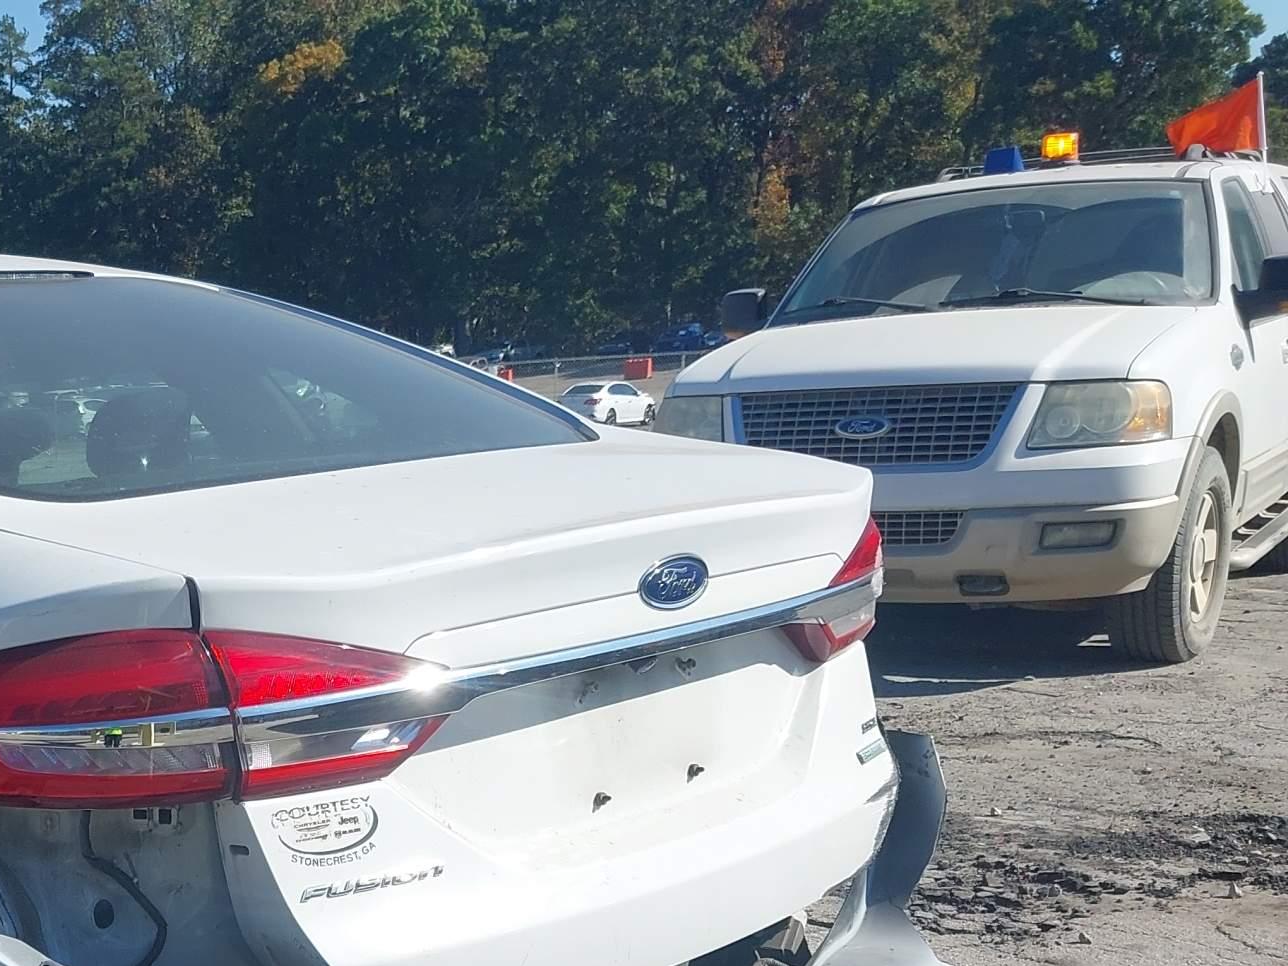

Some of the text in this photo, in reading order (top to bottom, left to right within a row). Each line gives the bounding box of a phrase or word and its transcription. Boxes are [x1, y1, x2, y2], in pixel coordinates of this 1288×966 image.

[273, 795, 371, 822] COURTESY
[338, 815, 360, 826] Jeep
[362, 841, 377, 856] GA
[299, 864, 445, 904] FUSION
